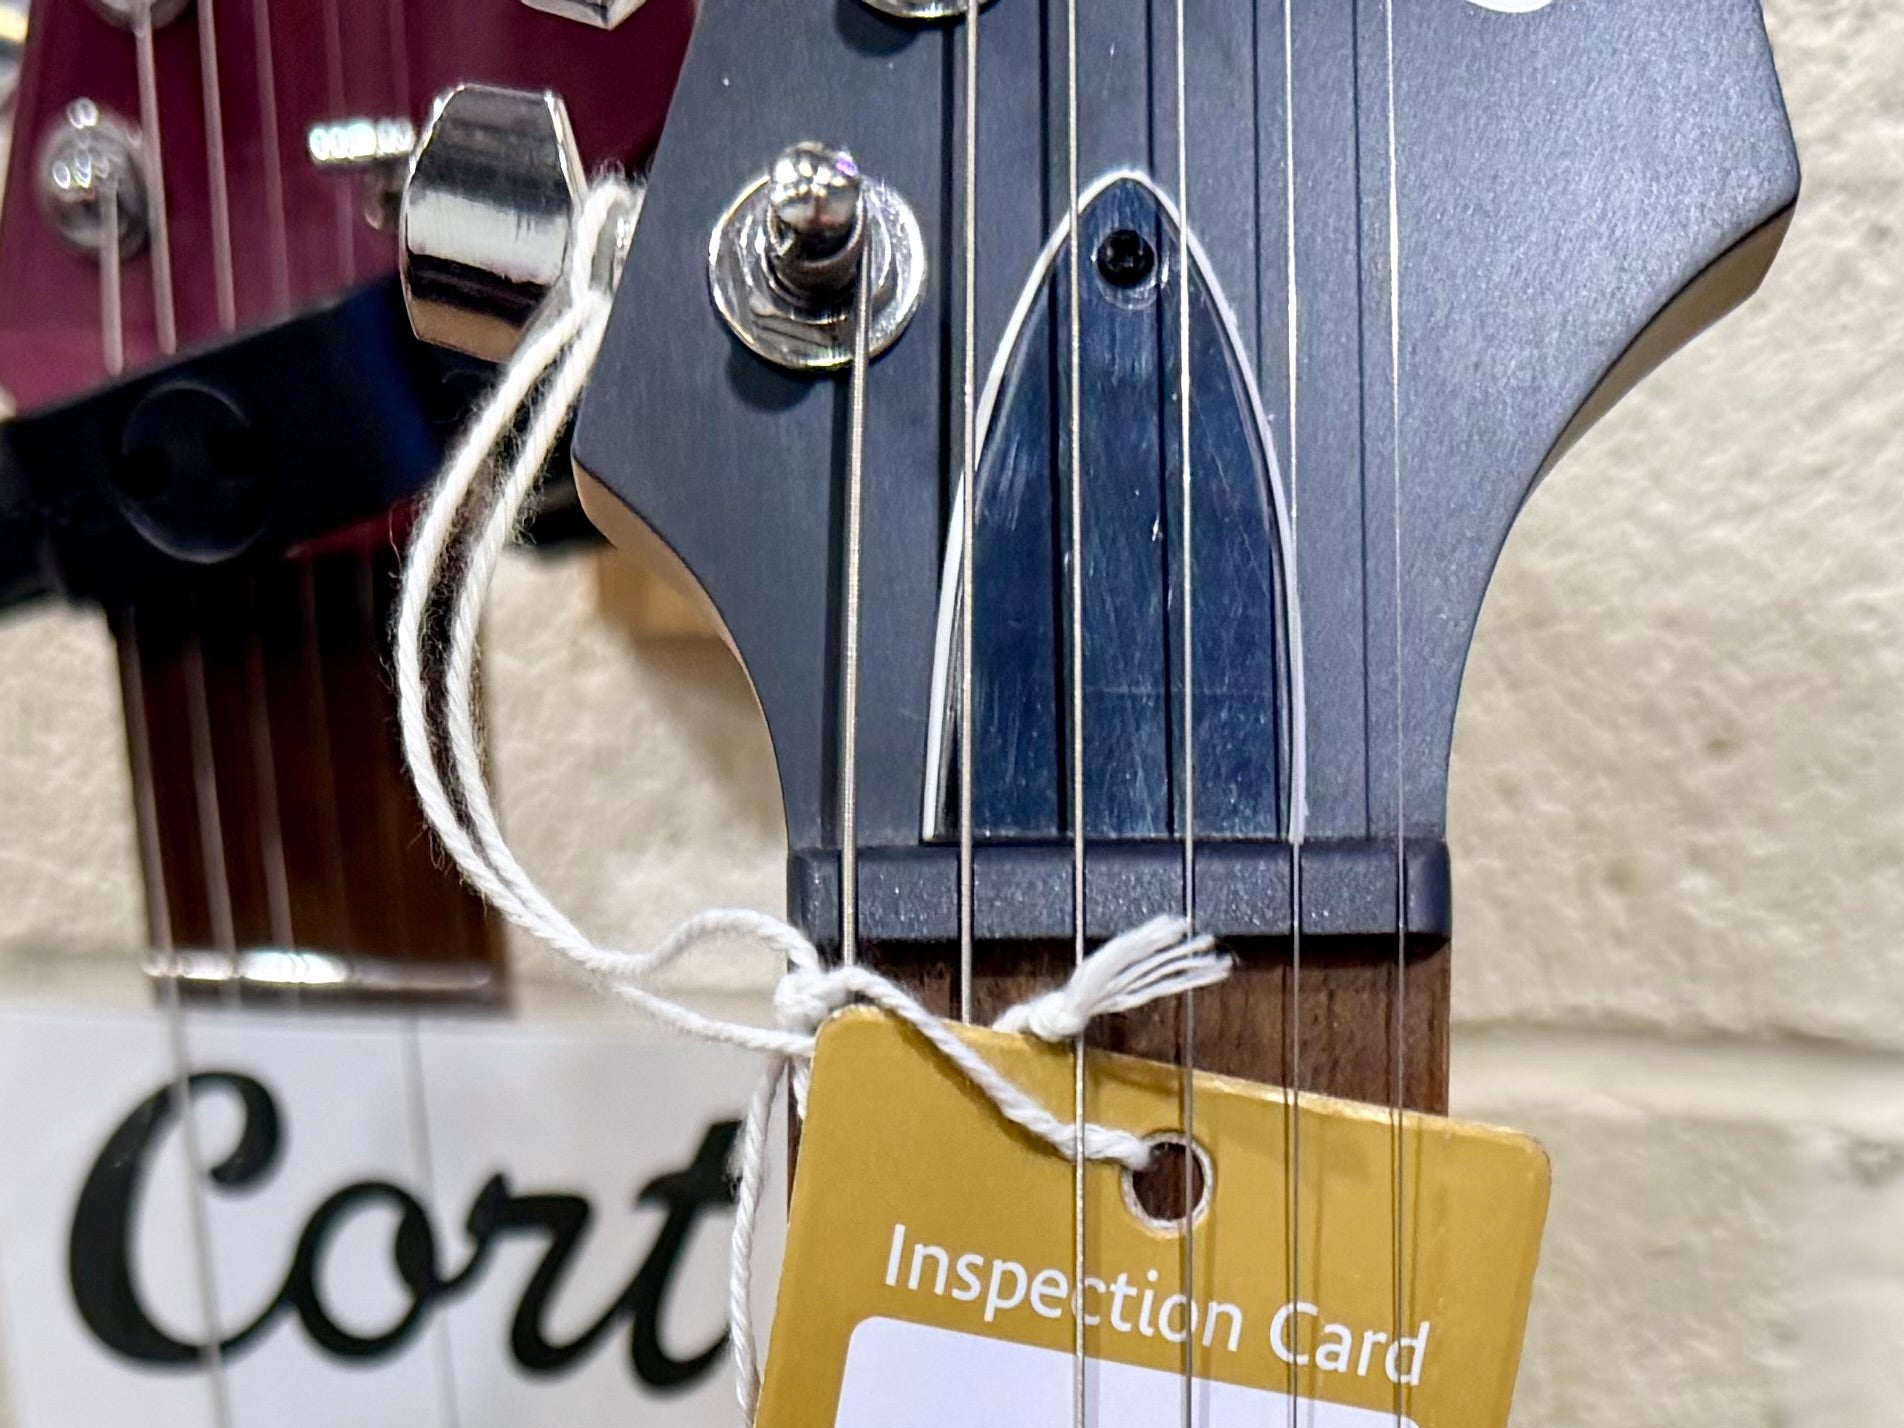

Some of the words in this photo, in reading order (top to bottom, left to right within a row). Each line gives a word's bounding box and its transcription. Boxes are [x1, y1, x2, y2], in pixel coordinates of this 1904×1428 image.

[66, 1070, 744, 1394] Cort
[884, 1223, 1243, 1353] Inspection
[1269, 1300, 1431, 1387] Card
